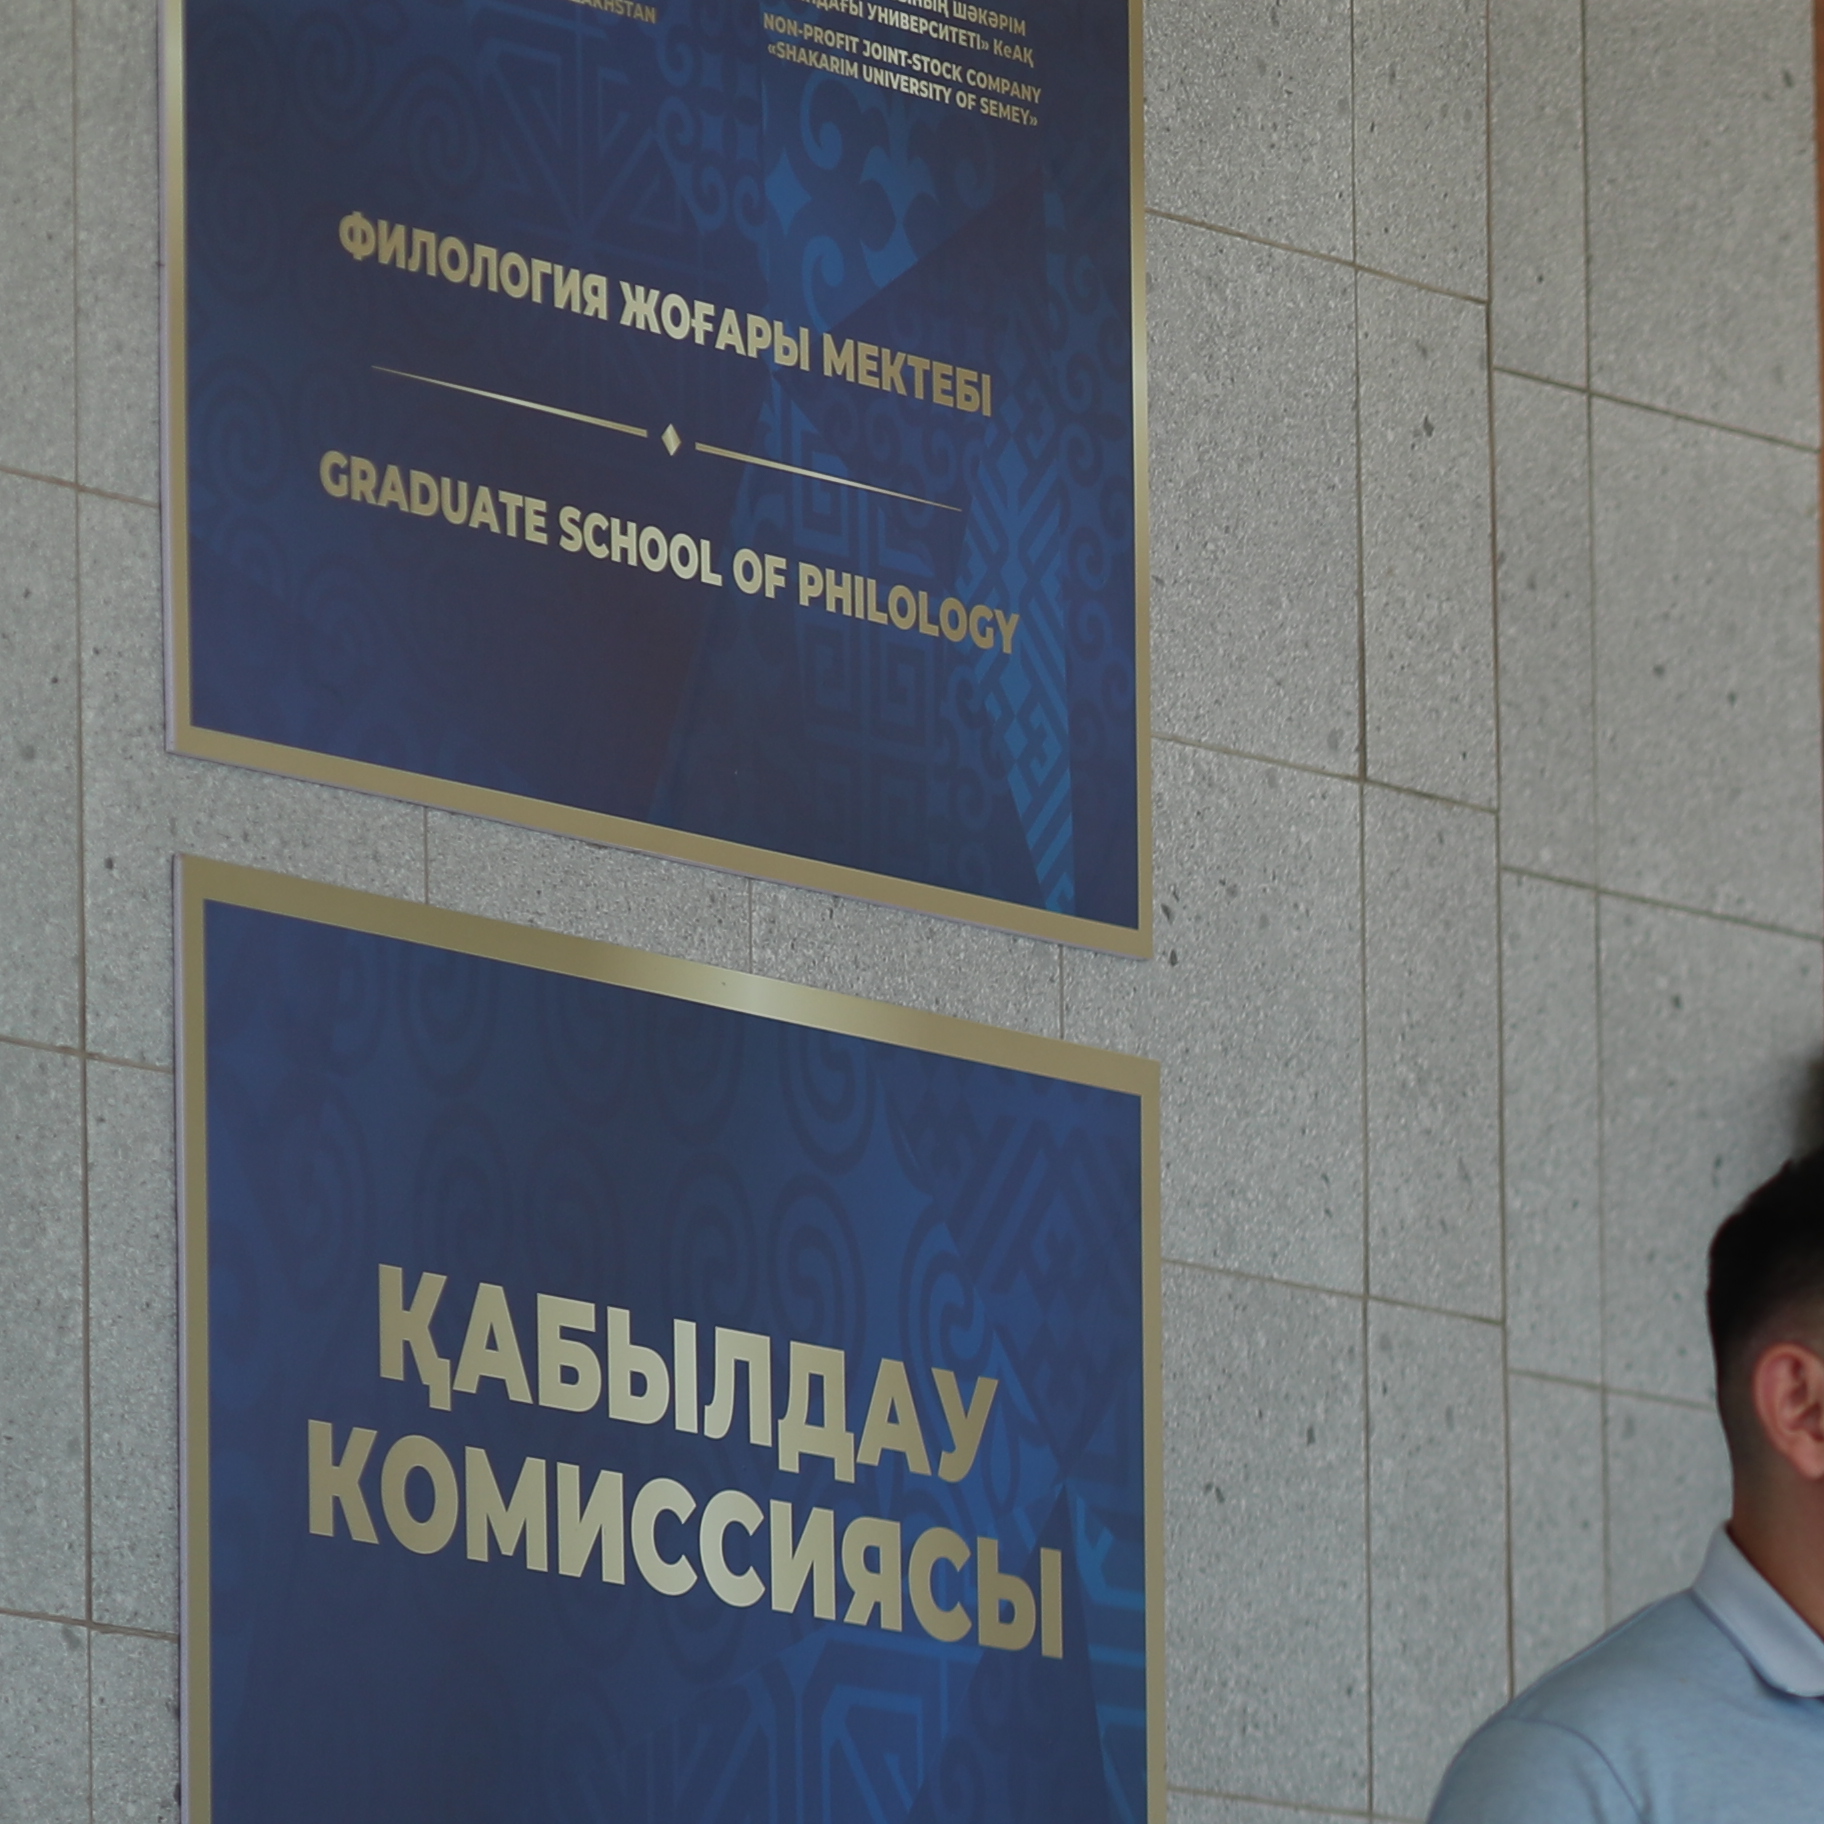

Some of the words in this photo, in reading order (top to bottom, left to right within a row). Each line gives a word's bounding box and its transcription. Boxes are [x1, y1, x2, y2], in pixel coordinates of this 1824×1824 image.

[763, 12, 860, 53] NON-PROFIT
[863, 39, 963, 84] JOINT-STOCK
[966, 69, 1042, 104] COMPANY
[767, 41, 859, 79] «SHAKARIM
[862, 64, 952, 104] UNIVERSITY
[955, 91, 977, 111] OF
[980, 97, 1038, 127] SEMEY»
[867, 3, 989, 51] УНИВЕРСИТЕТІ»
[953, 0, 1026, 36] ШӘКӘРІМ
[339, 212, 608, 321] ФИЛОЛОГИЯ
[619, 281, 810, 372] ЖОҒАРЫ
[822, 333, 992, 417] МЕКТЕБІ
[319, 451, 548, 546] GRADUATE
[558, 506, 722, 587] SCHOOL
[733, 548, 787, 599] OF
[799, 562, 1020, 655] PHILOLOGY
[378, 1263, 999, 1484] ҚАБЫЛДАУ
[307, 1418, 1064, 1660] КОМИССИЯСЫ
